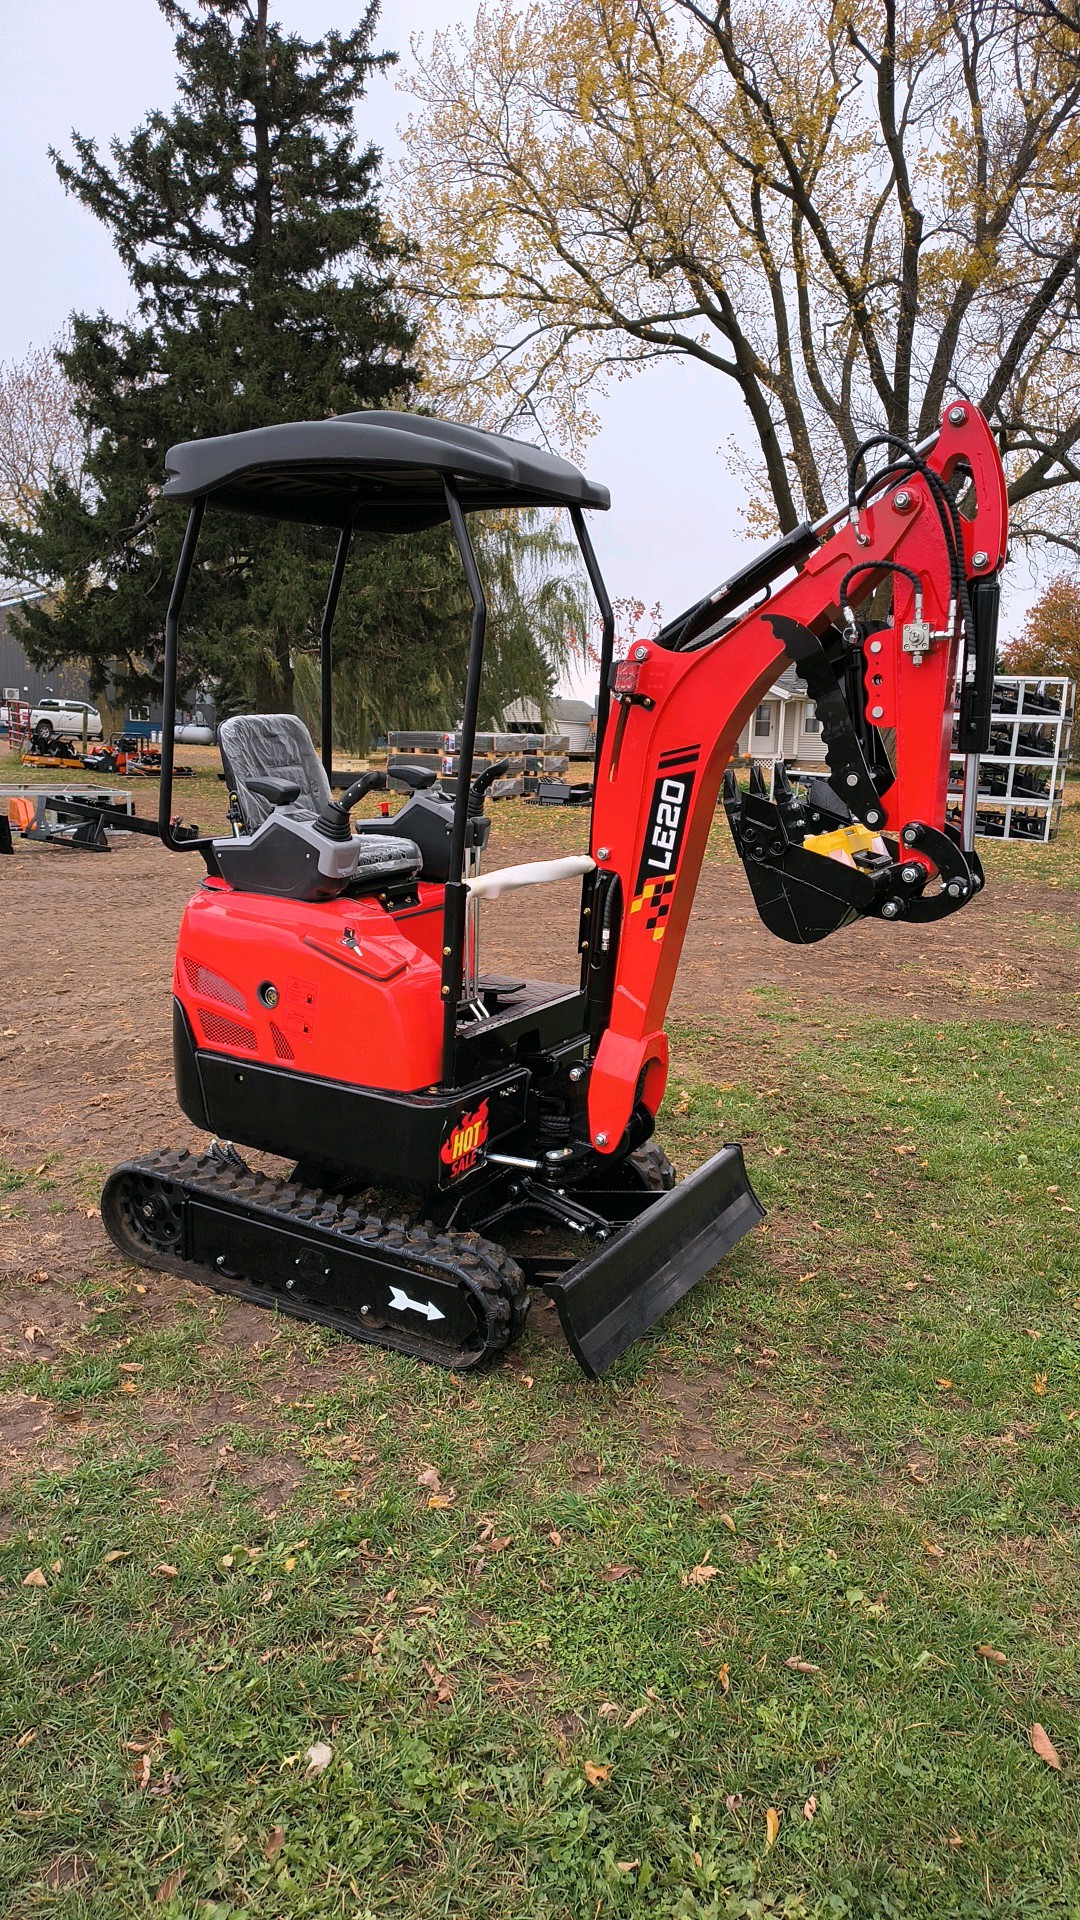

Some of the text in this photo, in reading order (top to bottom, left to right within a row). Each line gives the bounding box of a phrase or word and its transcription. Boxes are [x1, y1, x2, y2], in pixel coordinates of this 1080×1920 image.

[648, 779, 685, 870] LE20
[452, 1120, 482, 1160] HOT
[450, 1150, 477, 1178] SALE
